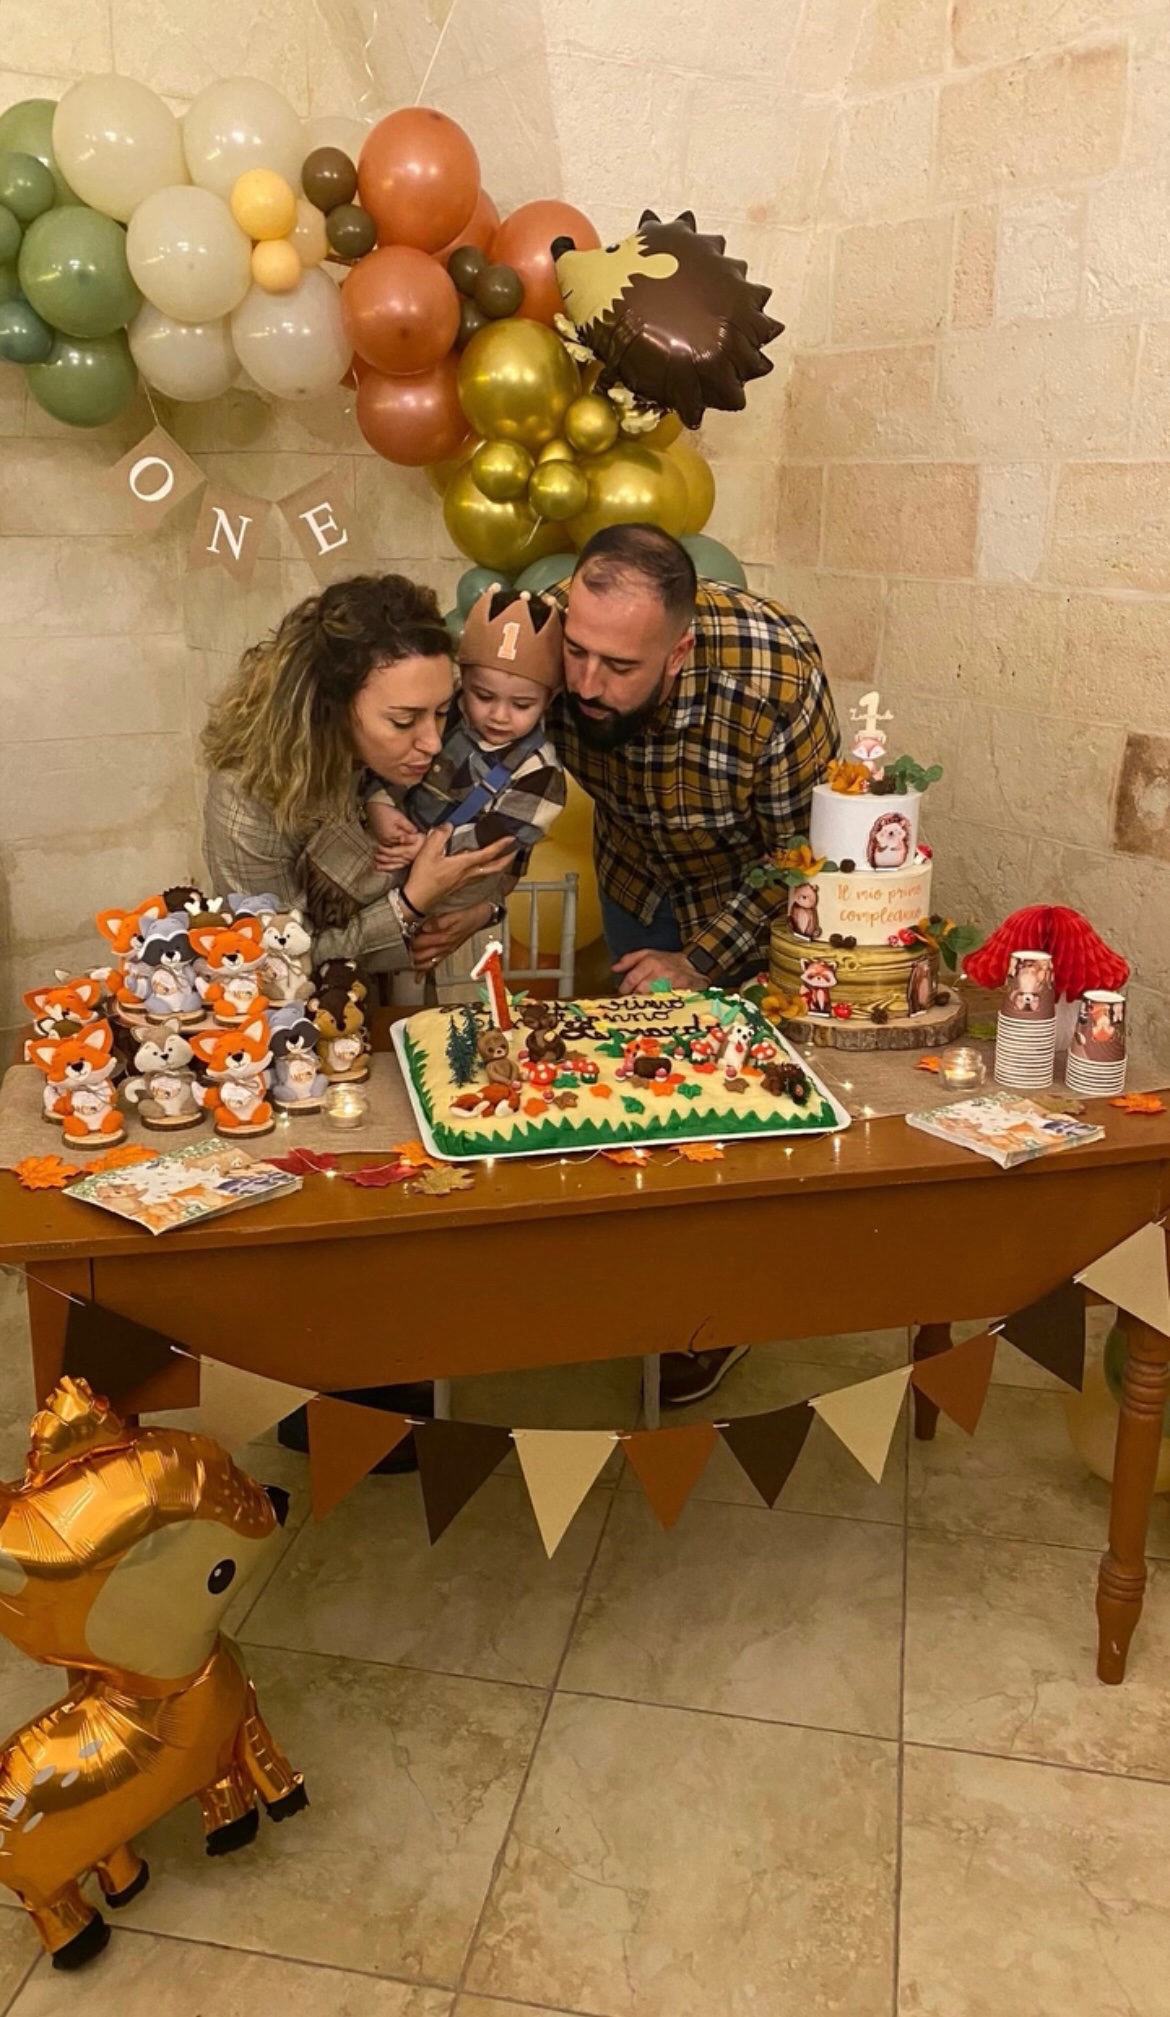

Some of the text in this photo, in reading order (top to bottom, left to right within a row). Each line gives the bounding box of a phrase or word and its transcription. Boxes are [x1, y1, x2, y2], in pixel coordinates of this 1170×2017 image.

[129, 457, 348, 560] ONE
[497, 622, 520, 660] 1
[859, 691, 880, 736] 1
[470, 941, 513, 1032] 1
